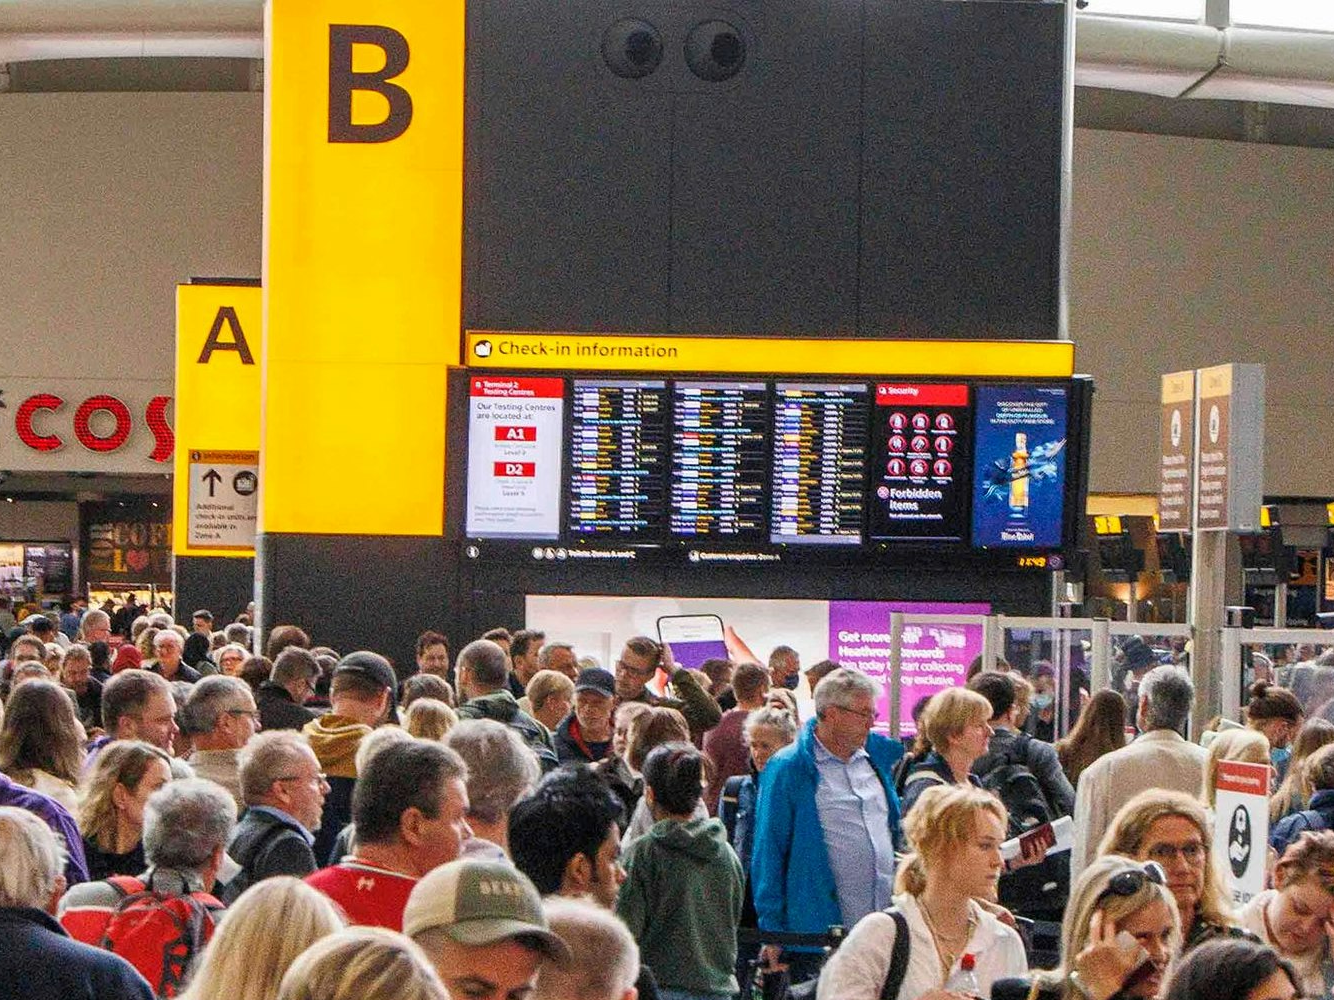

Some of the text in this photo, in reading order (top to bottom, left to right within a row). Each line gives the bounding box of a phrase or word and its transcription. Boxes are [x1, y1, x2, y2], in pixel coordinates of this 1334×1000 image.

[327, 24, 413, 144] B
[198, 306, 255, 366] A
[499, 341, 678, 359] Check-in information
[484, 381, 512, 389] Terminal
[888, 386, 919, 396] Security
[484, 388, 508, 396] Testing
[495, 403, 522, 412] Testing
[525, 403, 556, 411] Centres
[492, 411, 521, 420] located
[507, 428, 525, 440] A1
[506, 463, 524, 476] D2
[890, 488, 943, 500] Forbidden
[889, 499, 919, 511] Items
[838, 631, 860, 643] Get
[861, 634, 891, 643] more
[901, 647, 945, 658] ewards
[859, 661, 885, 672] today
[920, 661, 964, 674] collecting
[914, 676, 955, 686] exclusive
